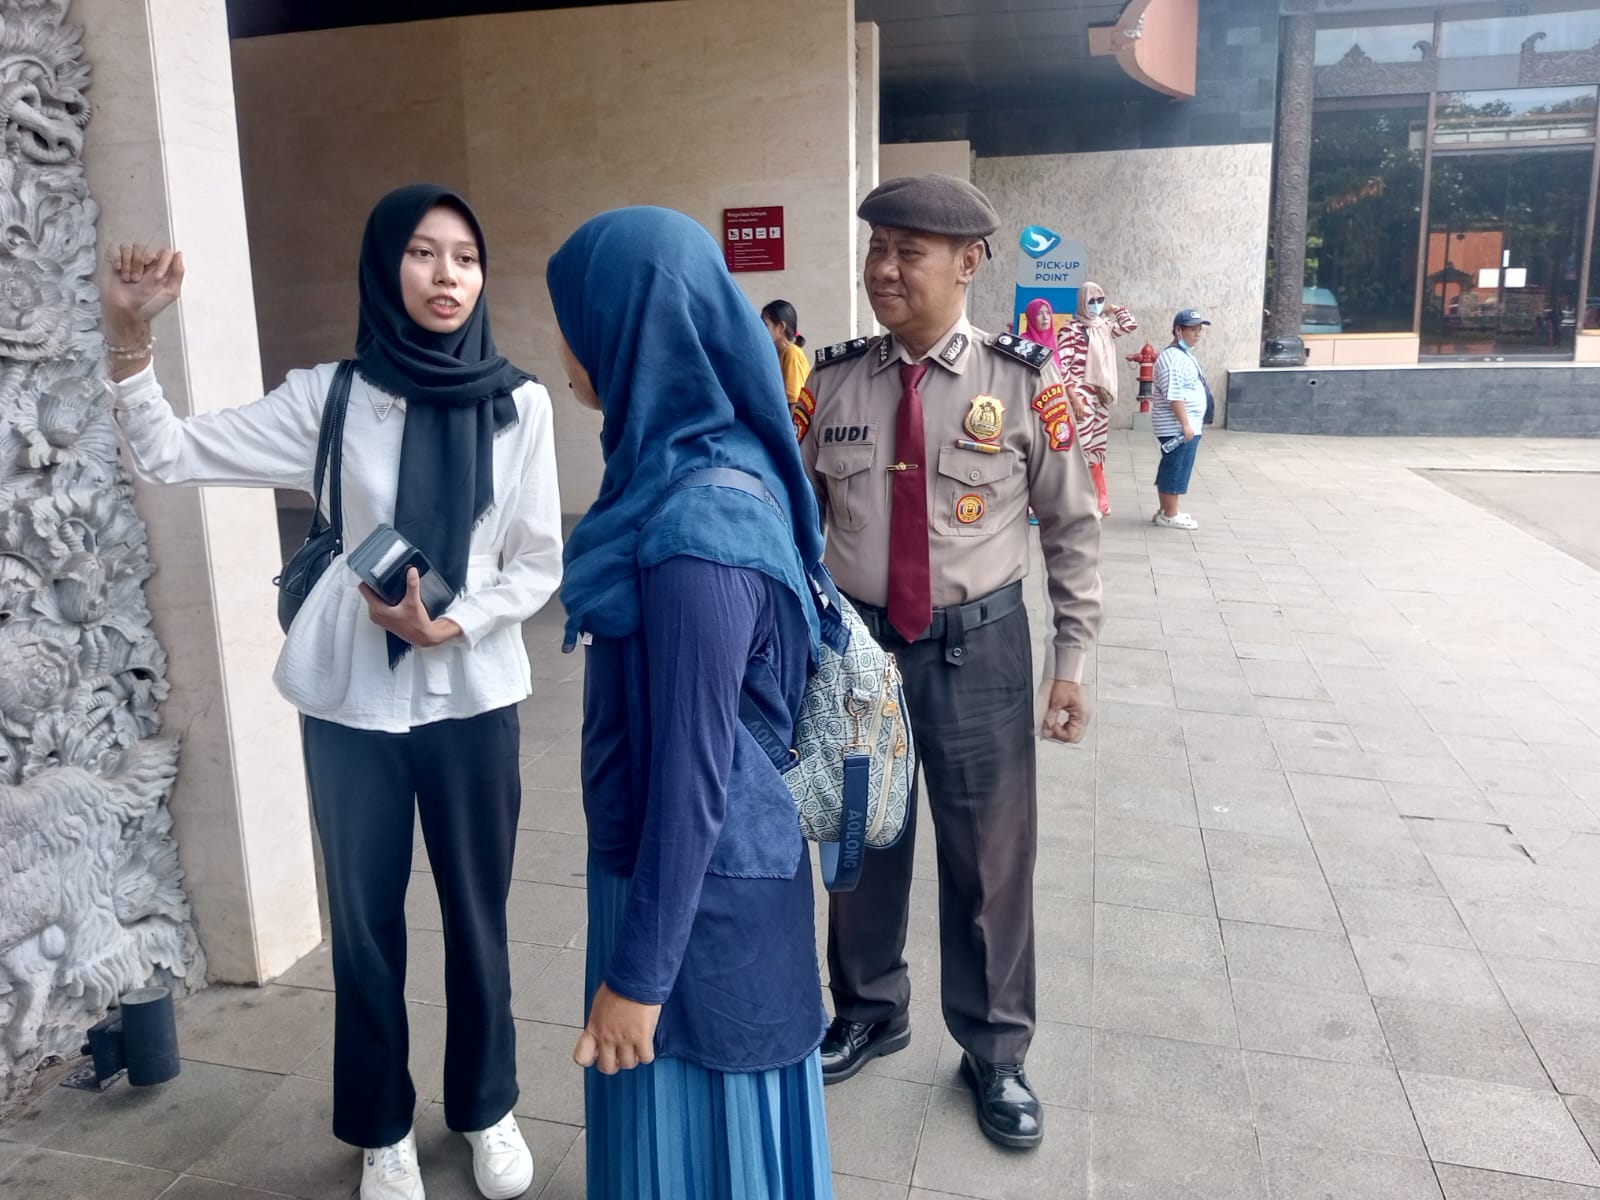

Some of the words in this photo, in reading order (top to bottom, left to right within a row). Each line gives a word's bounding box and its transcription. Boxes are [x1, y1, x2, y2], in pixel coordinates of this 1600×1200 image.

[1036, 261, 1080, 270] PICK-UP
[1035, 273, 1069, 282] POINT
[1036, 386, 1062, 409] POLDA
[824, 425, 868, 443] RUDI
[843, 809, 863, 869] AOLONG
